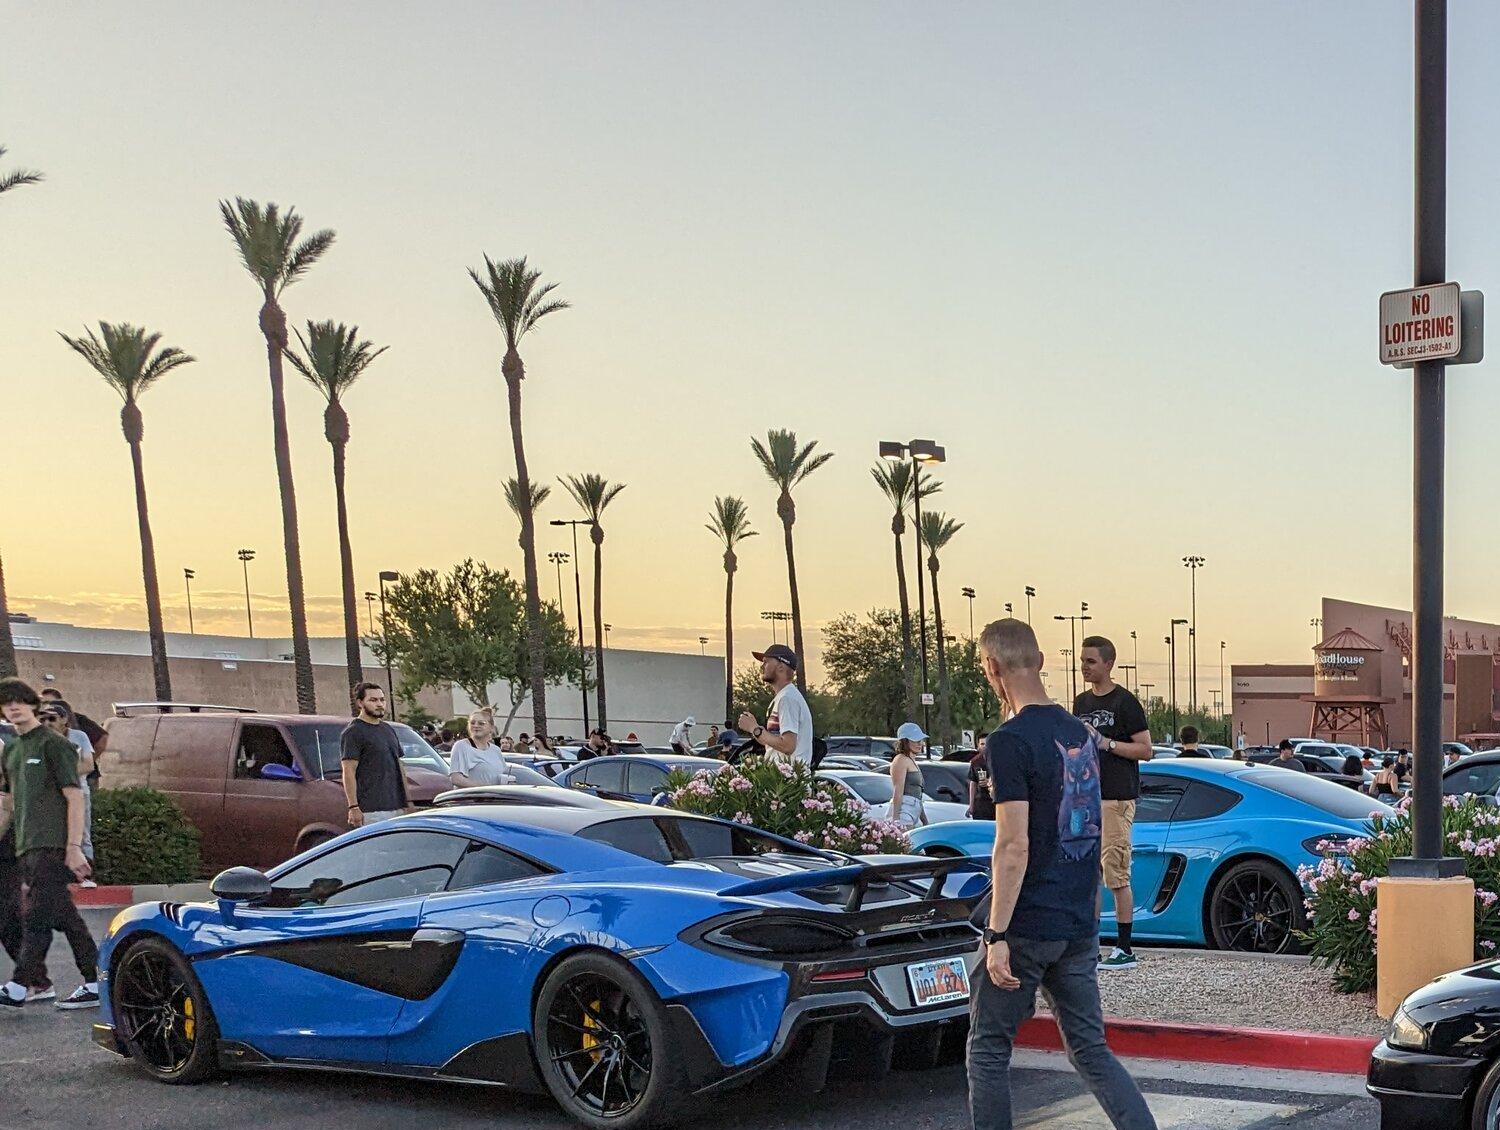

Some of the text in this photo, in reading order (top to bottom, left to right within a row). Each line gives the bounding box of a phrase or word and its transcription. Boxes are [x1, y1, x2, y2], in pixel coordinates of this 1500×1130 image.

[1412, 293, 1430, 316] NO
[1385, 316, 1454, 345] LOITERING
[927, 993, 963, 1004] McLaren
